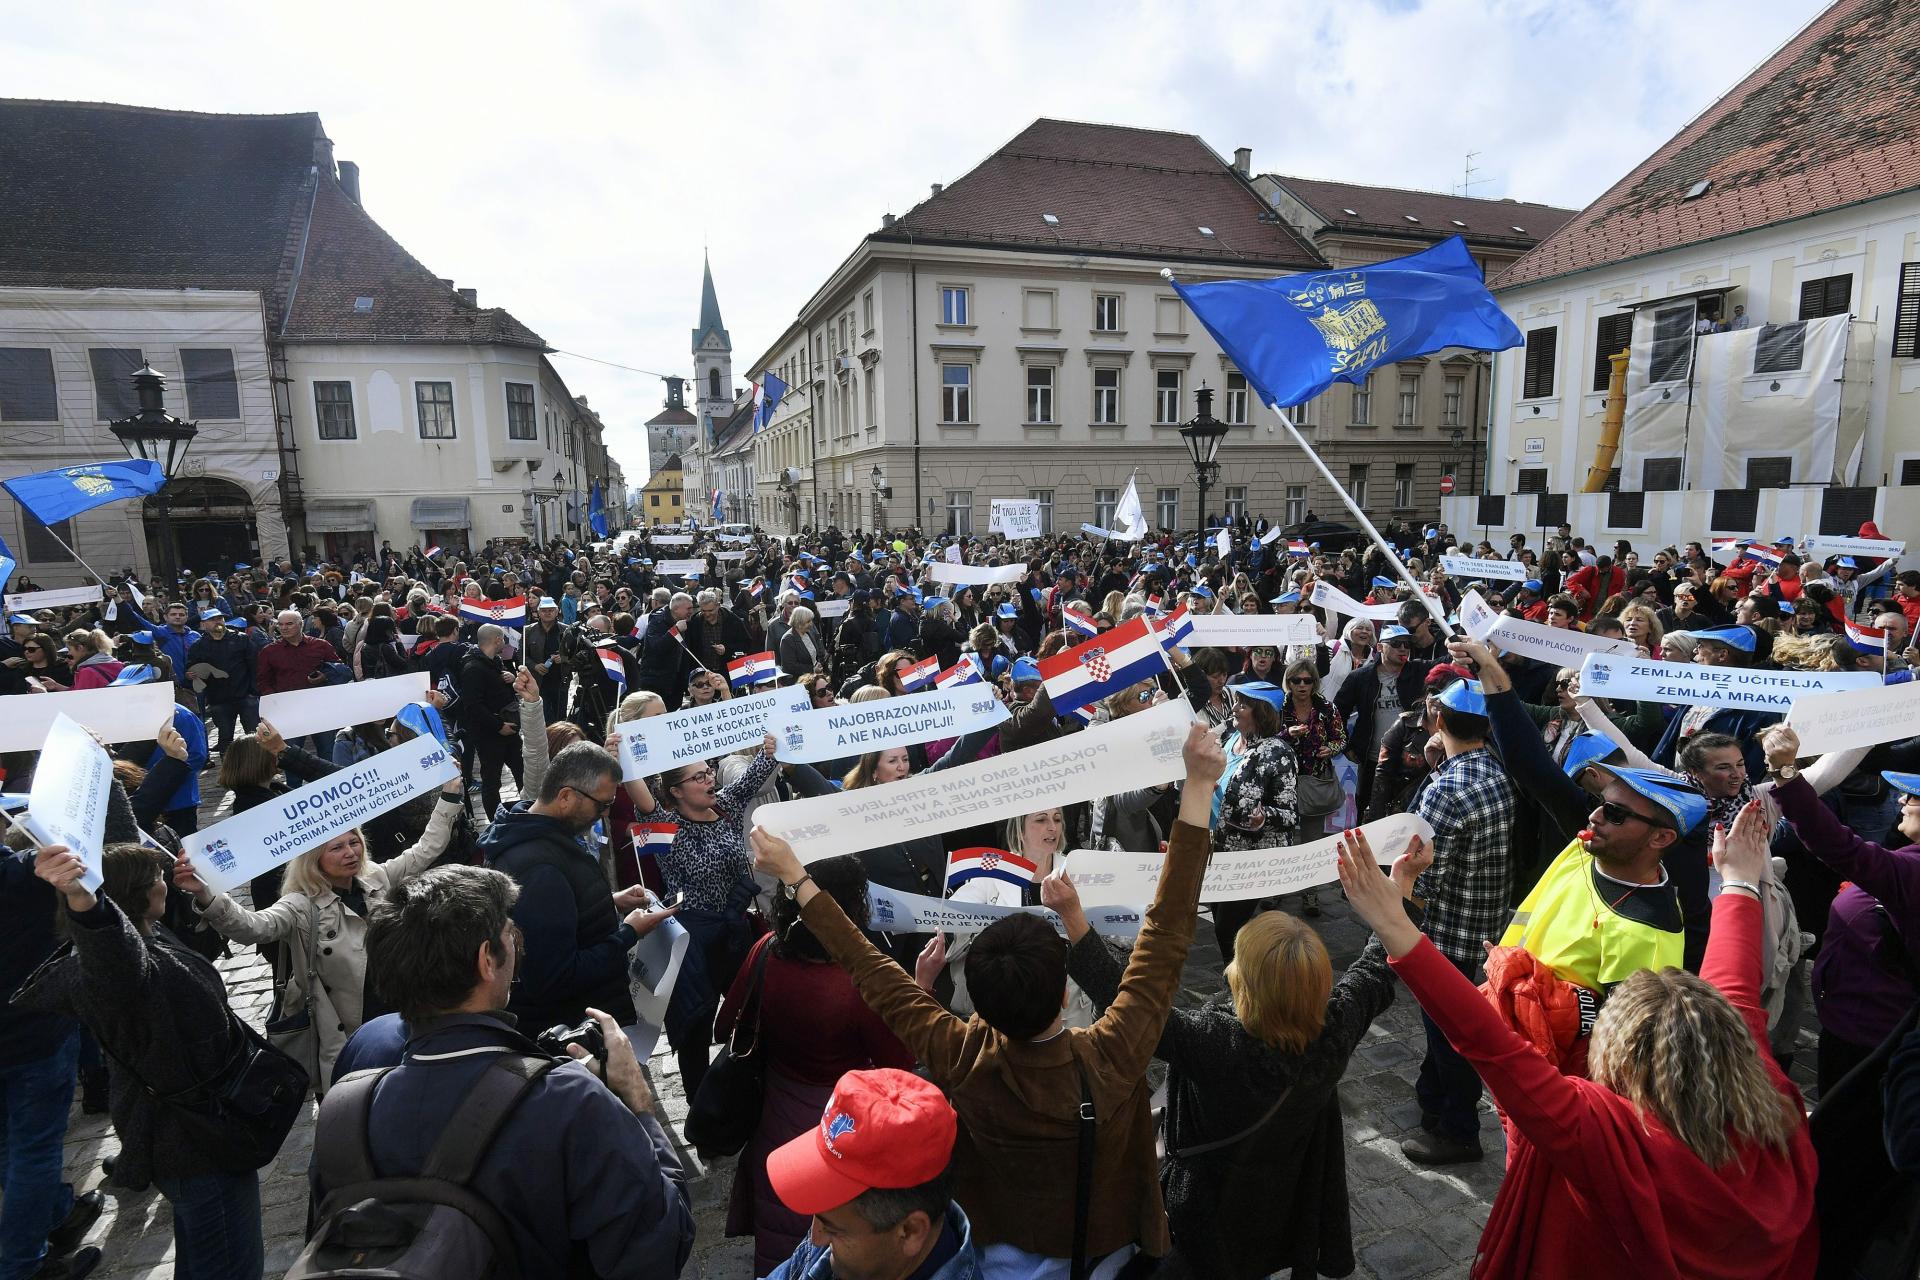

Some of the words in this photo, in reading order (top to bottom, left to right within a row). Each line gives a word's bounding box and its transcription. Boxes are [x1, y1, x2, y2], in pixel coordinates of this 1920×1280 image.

[1501, 630, 1511, 639] SE
[1511, 632, 1517, 640] S
[1517, 634, 1544, 647] OVOM
[1545, 640, 1584, 656] PLAĆOM!
[1630, 666, 1695, 680] ZEMLJA
[1699, 672, 1733, 683] BEZ
[1738, 674, 1824, 689] UČITELJA
[789, 700, 811, 713] SHU
[970, 699, 996, 714] SHU
[1656, 686, 1722, 700] ZEMLJA
[1727, 691, 1793, 705] MRAKA
[666, 718, 689, 731] TKO
[691, 712, 714, 725] VAM
[716, 709, 728, 720] JE
[730, 697, 777, 717] DOZVOLIO
[683, 730, 699, 742] DA
[701, 726, 714, 737] SE
[717, 714, 761, 734] KOCKATE
[827, 700, 957, 730] NAJOBRAZOVANIJI,
[672, 741, 712, 760] NAŠOM
[714, 724, 769, 748] BUDUĆNOŠ
[836, 732, 847, 746] A
[848, 728, 869, 744] NE
[871, 714, 955, 741] NAJGLUPLJI!
[420, 749, 446, 769] SHU
[262, 830, 287, 847] OVA
[287, 808, 331, 835] ZEMLJA
[331, 792, 367, 816] PLUTA
[366, 770, 411, 800] ZADNJIM
[282, 768, 380, 821] UPOMOĆ!!!
[269, 824, 331, 859] NAPORIMA
[330, 805, 368, 830] NJENIH
[368, 782, 415, 812] UČITELJA
[957, 920, 973, 928] JE
